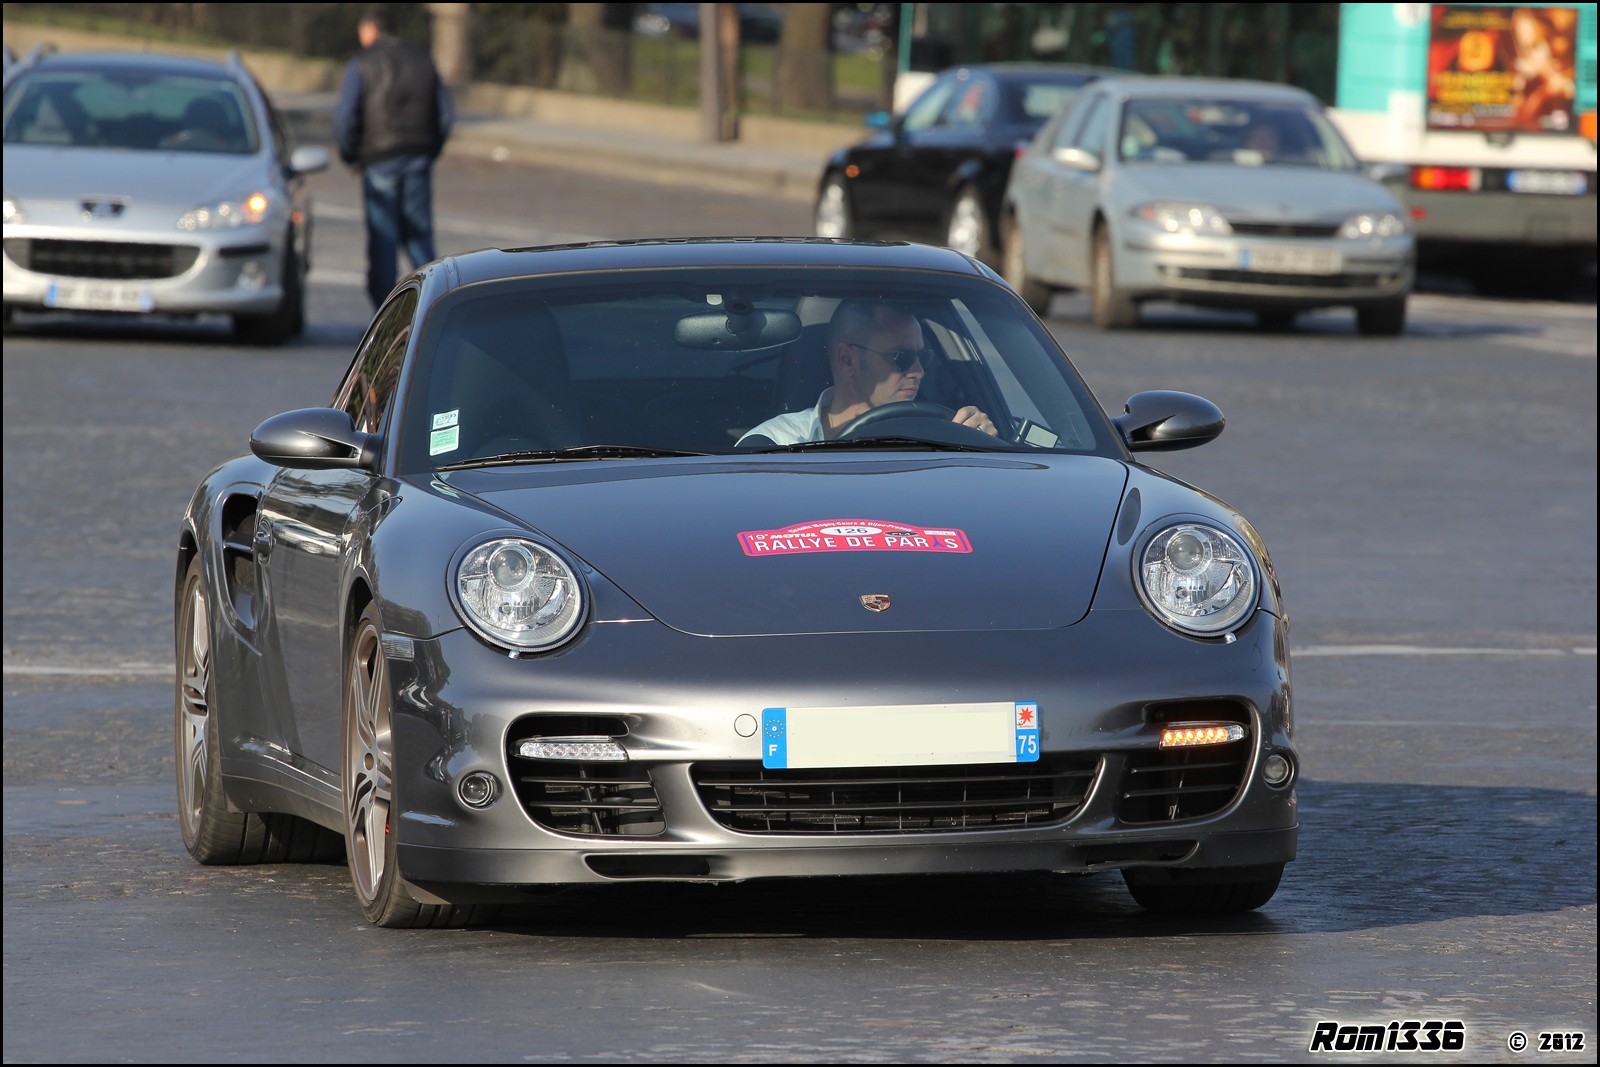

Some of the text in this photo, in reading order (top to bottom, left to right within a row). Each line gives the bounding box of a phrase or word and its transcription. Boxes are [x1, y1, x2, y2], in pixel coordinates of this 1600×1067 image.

[769, 532, 819, 540] MOTUL
[834, 527, 868, 535] 126
[754, 537, 837, 552] RALLYE
[845, 536, 876, 547] DE
[768, 744, 778, 757] F
[1018, 735, 1037, 755] 75
